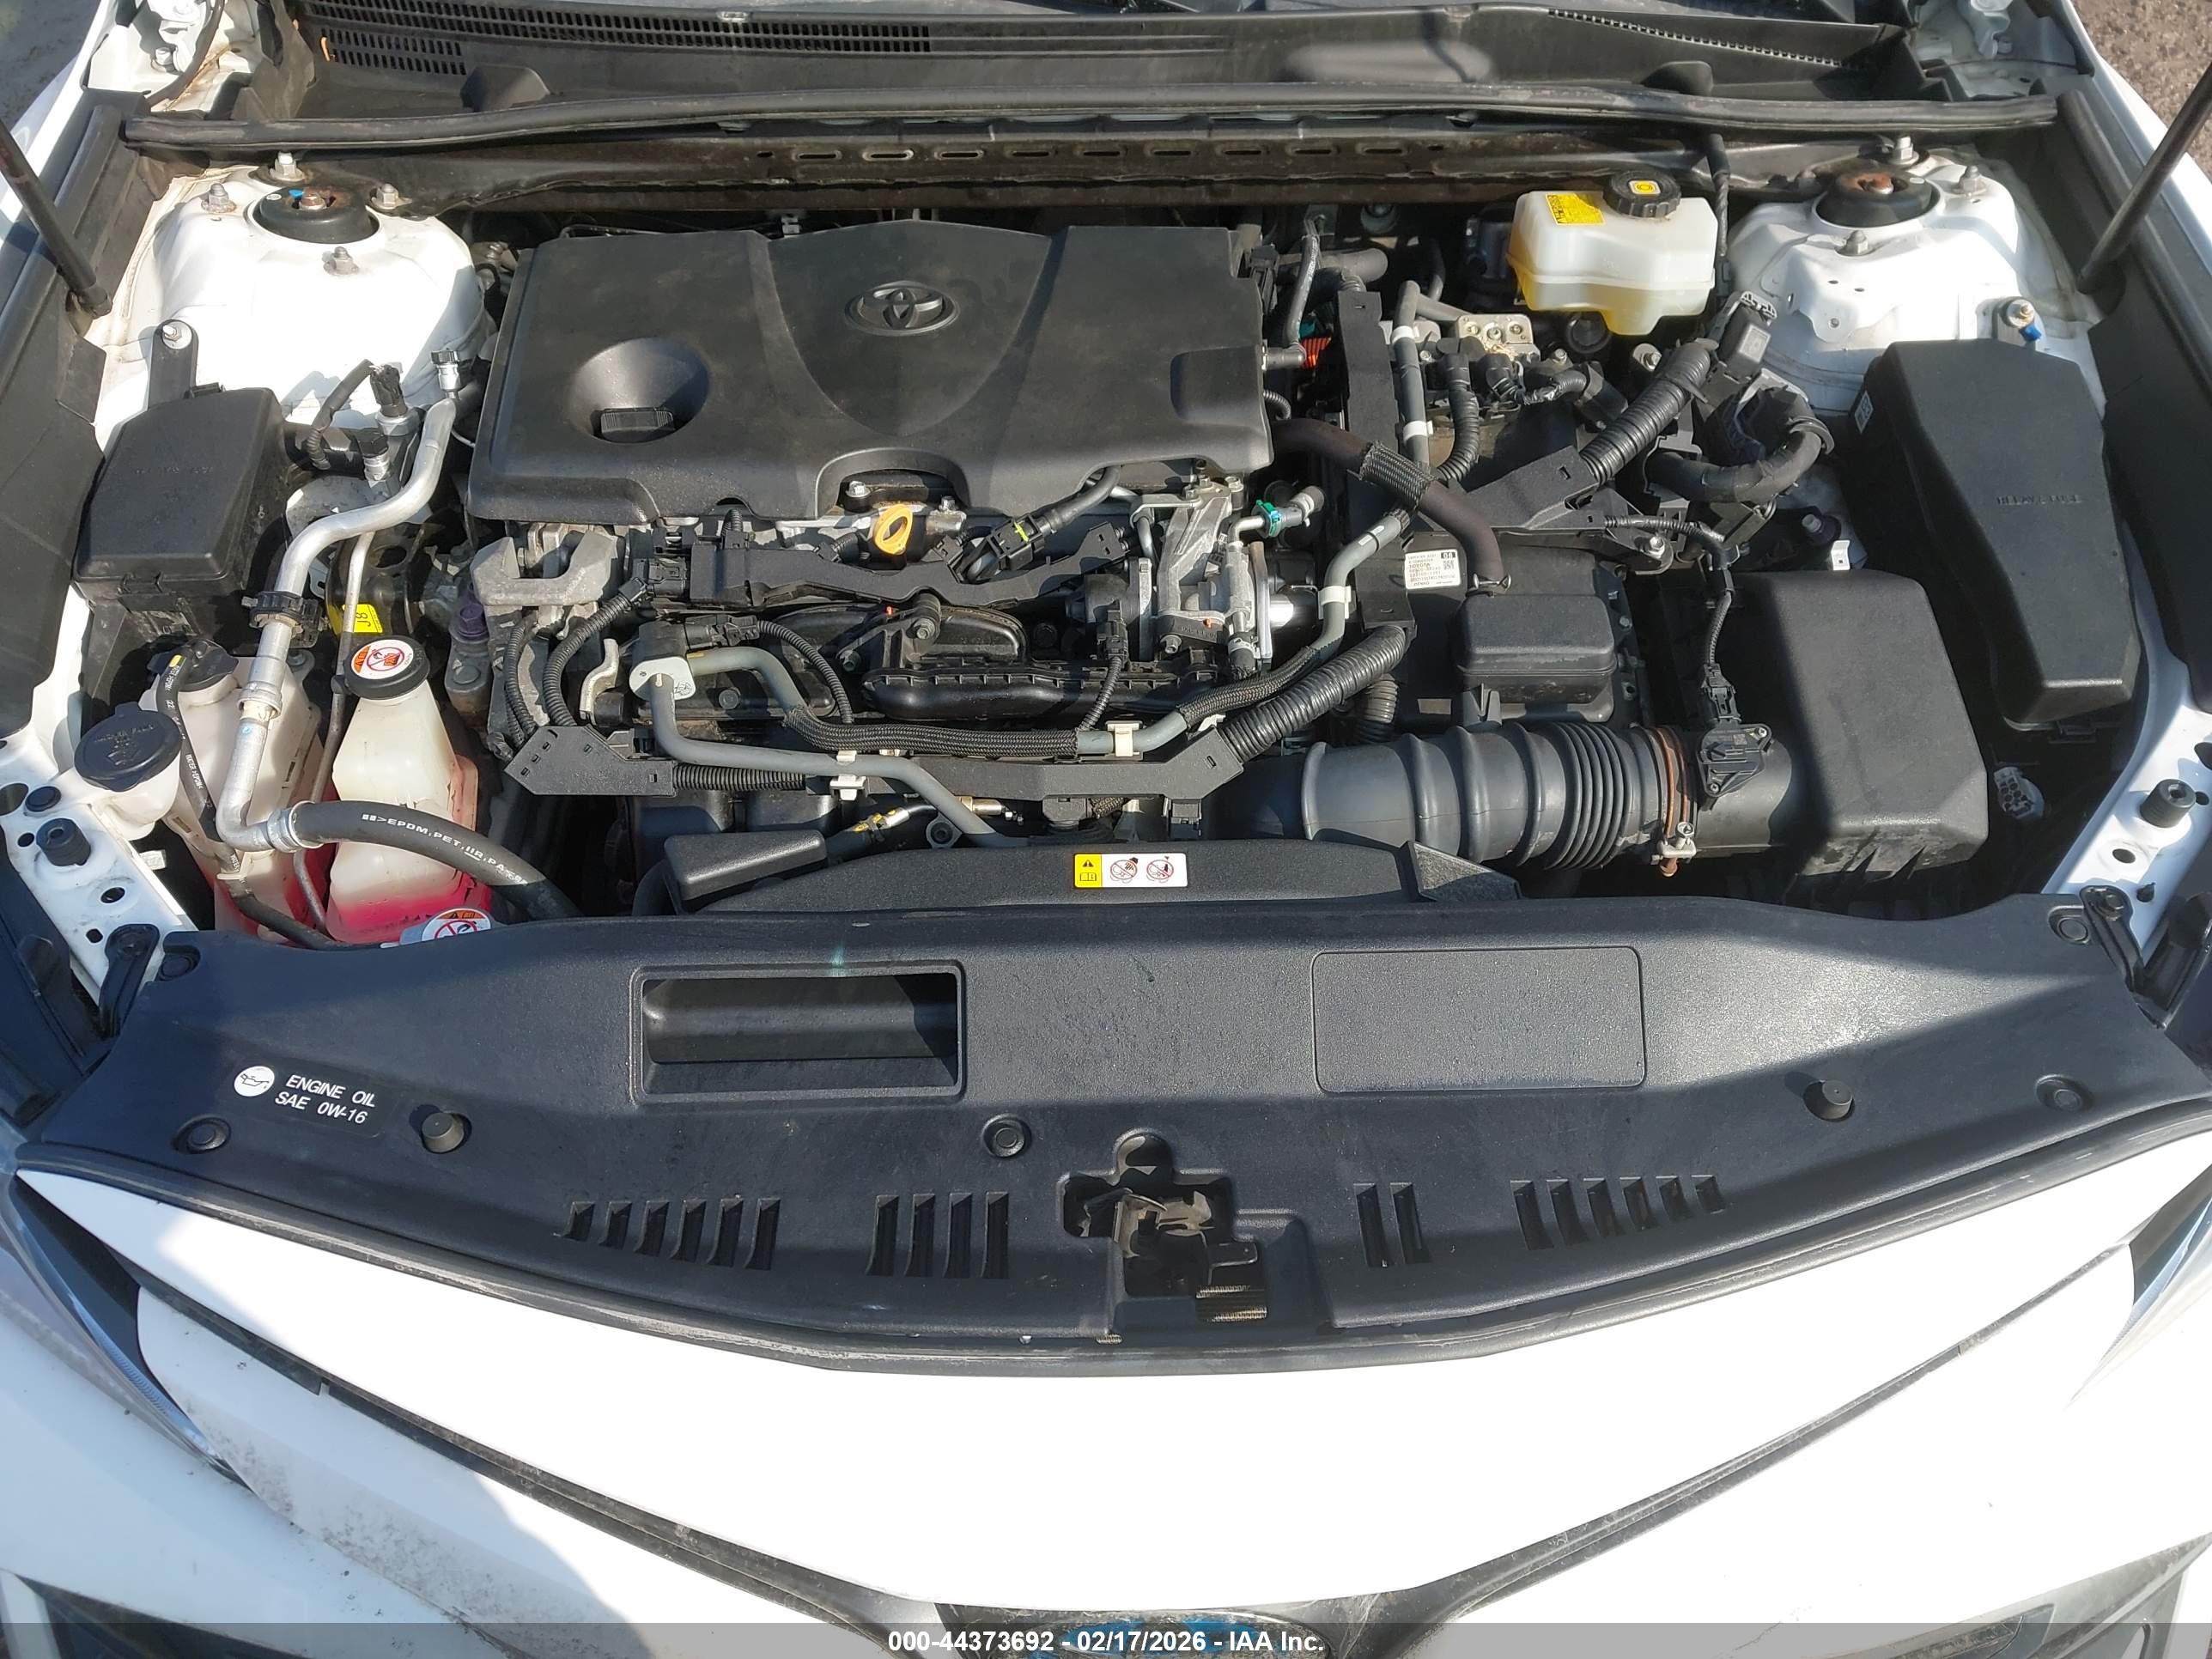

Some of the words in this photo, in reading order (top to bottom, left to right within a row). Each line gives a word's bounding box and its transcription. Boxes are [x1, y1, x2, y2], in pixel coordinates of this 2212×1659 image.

[275, 1091, 311, 1110] SAE
[317, 1102, 368, 1125] 0W-16
[286, 1074, 346, 1099] ENGINE
[351, 1091, 376, 1108] OIL
